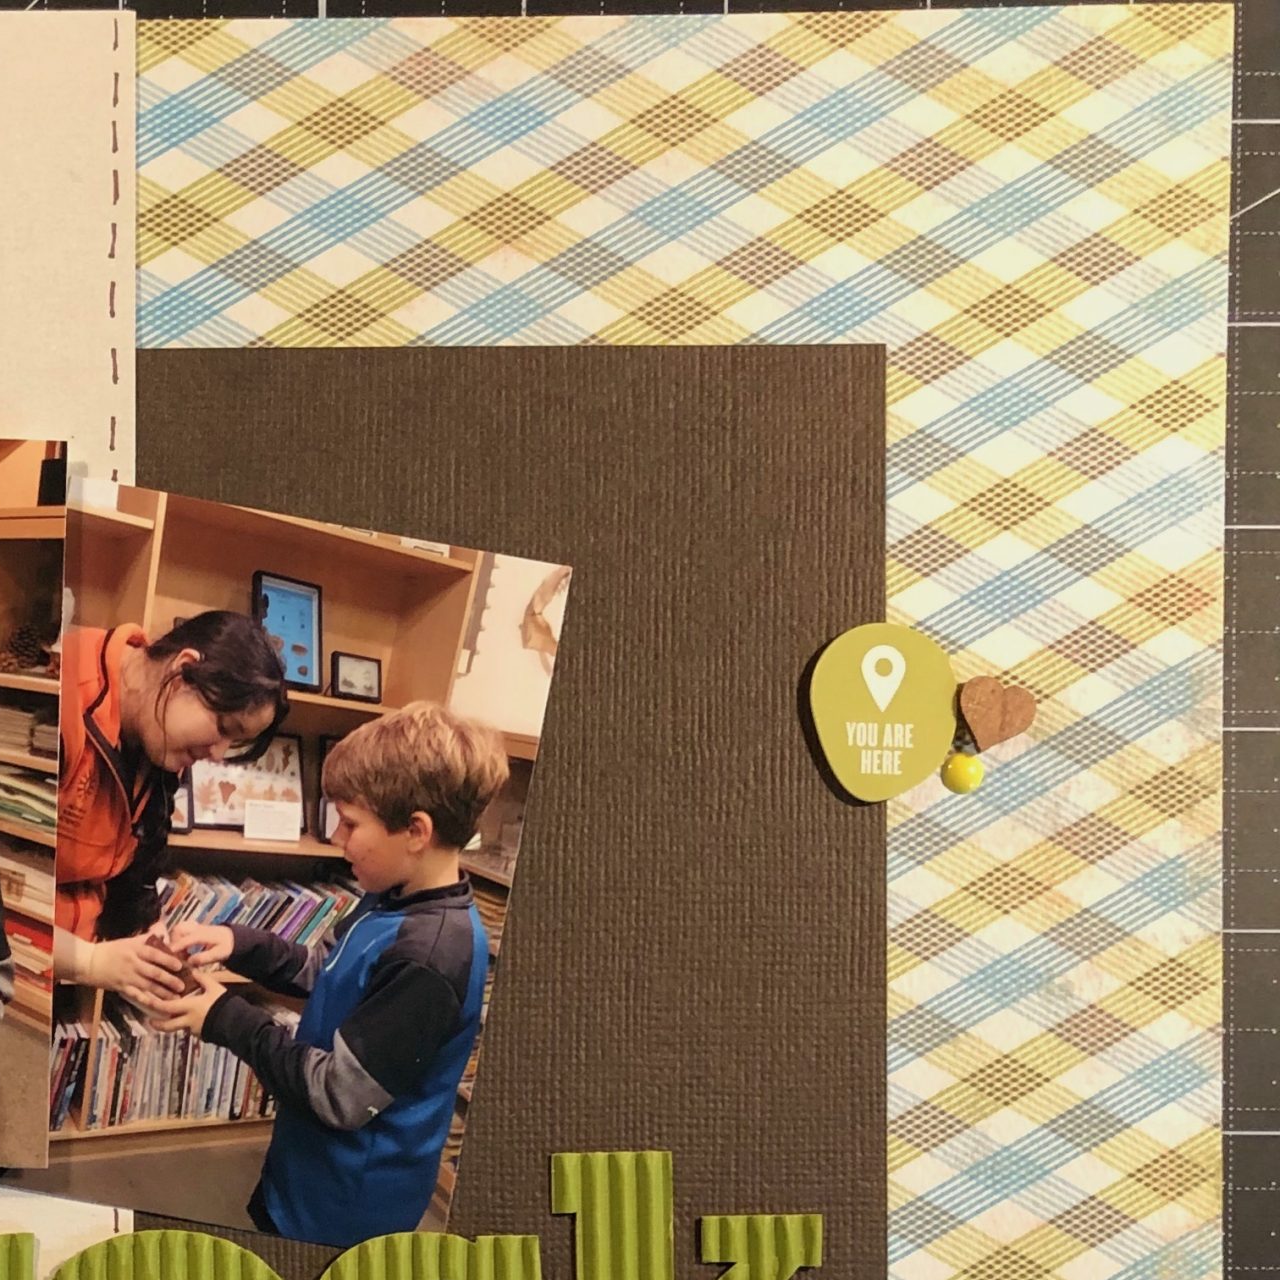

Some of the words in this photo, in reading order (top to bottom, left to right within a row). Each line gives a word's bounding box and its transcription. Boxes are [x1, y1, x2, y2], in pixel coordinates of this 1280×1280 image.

[845, 721, 878, 747] YOU
[883, 723, 914, 748] ARE
[860, 749, 903, 775] HERE
